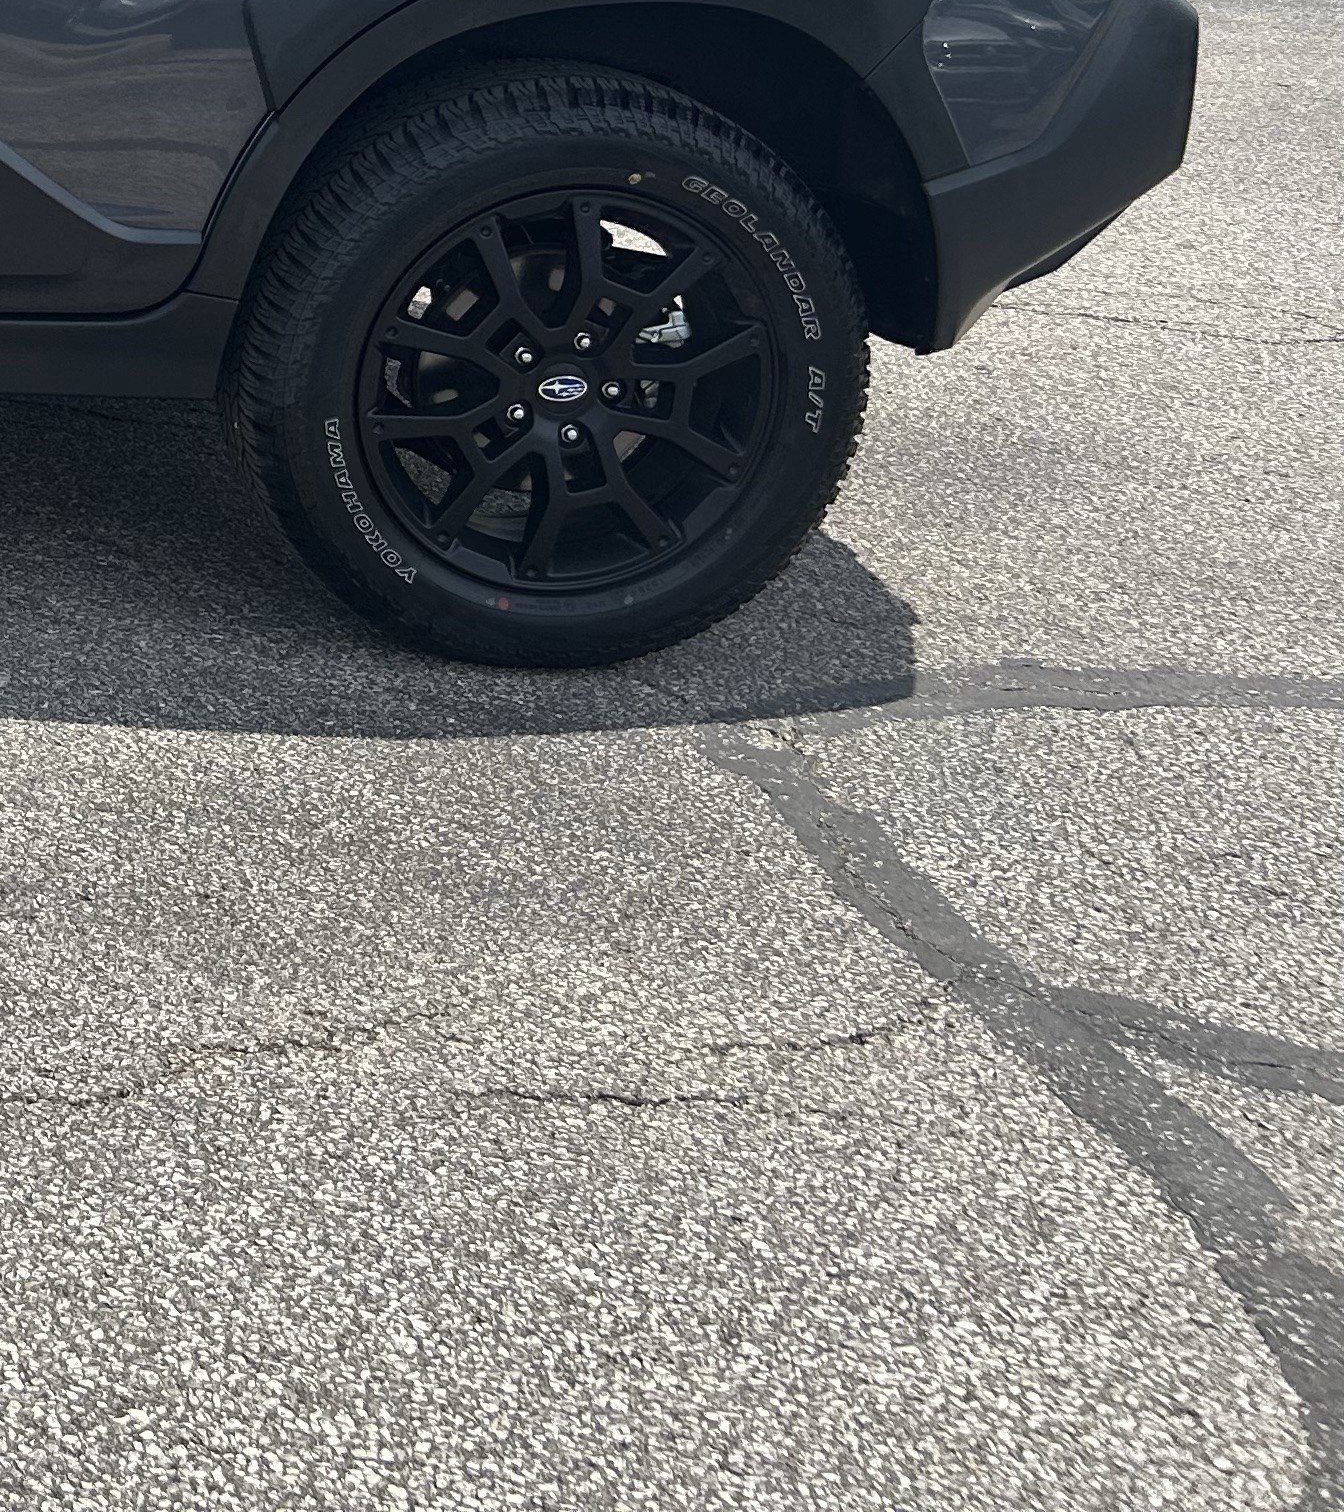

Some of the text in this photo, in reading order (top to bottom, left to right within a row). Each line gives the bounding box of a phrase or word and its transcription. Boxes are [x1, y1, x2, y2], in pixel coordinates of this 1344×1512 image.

[681, 175, 826, 433] GEOLANDAR A/T
[324, 418, 418, 584] YOKOHAMA
